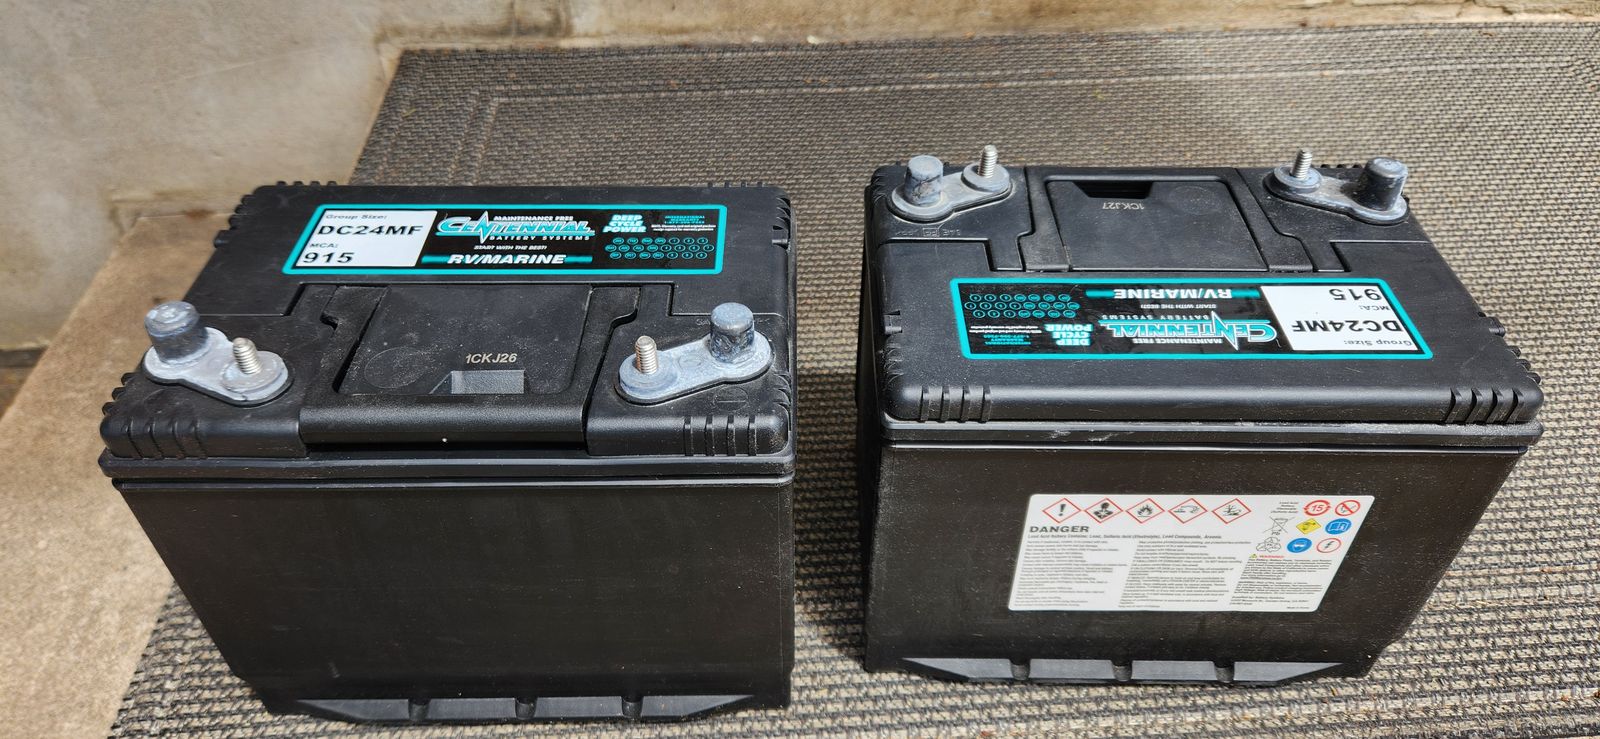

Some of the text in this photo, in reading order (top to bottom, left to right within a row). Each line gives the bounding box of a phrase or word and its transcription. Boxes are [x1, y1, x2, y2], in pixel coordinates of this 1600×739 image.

[1102, 202, 1145, 211] 1CKJ27
[318, 225, 423, 236] DC24MF
[436, 211, 594, 244] CENTENNIAL
[303, 252, 355, 264] 915
[447, 254, 567, 265] RV/MARINE
[1113, 288, 1233, 299] RV/MARINE
[1328, 288, 1382, 301] 915
[1044, 323, 1093, 332] POWER
[1104, 311, 1278, 351] CENTENNIAL
[1291, 320, 1404, 332] DC24MF
[1051, 331, 1090, 339] CYCLE
[1055, 338, 1090, 346] DEEP
[465, 353, 518, 364] 1CKJ26
[1311, 504, 1324, 512] 15
[1029, 525, 1090, 533] DANGER
